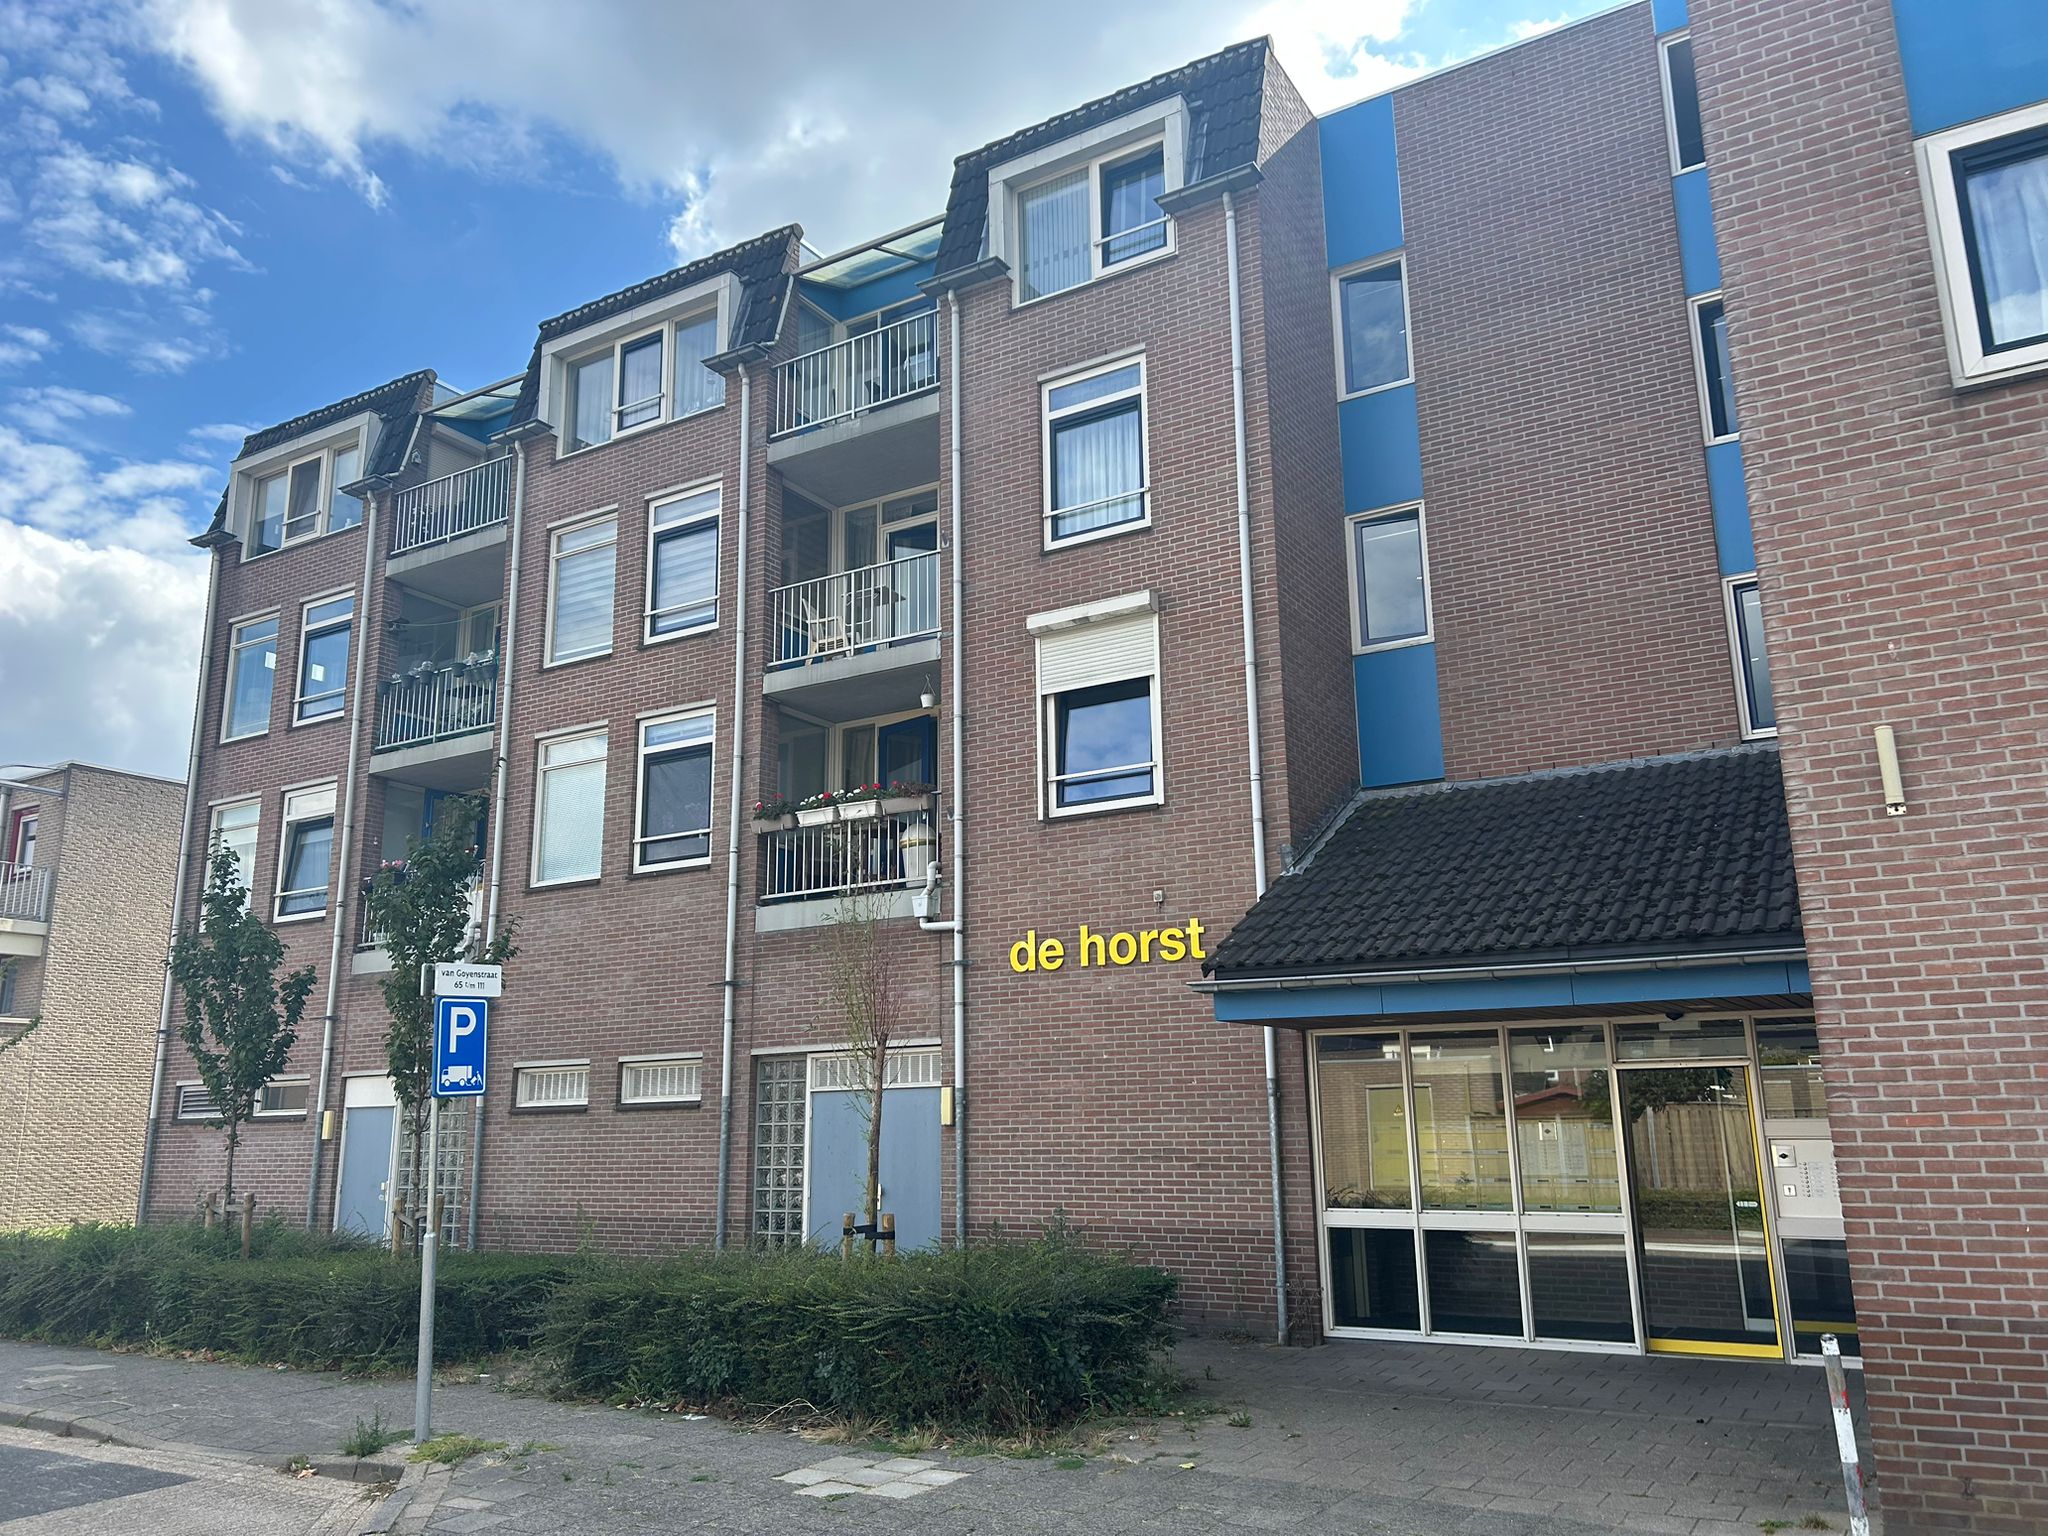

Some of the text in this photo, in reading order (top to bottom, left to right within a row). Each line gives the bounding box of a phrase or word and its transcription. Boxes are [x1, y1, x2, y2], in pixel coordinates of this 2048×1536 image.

[1009, 917, 1206, 973] de horst
[454, 981, 463, 989] 65
[456, 969, 498, 979] Goyenstraat
[449, 1006, 477, 1053] P
